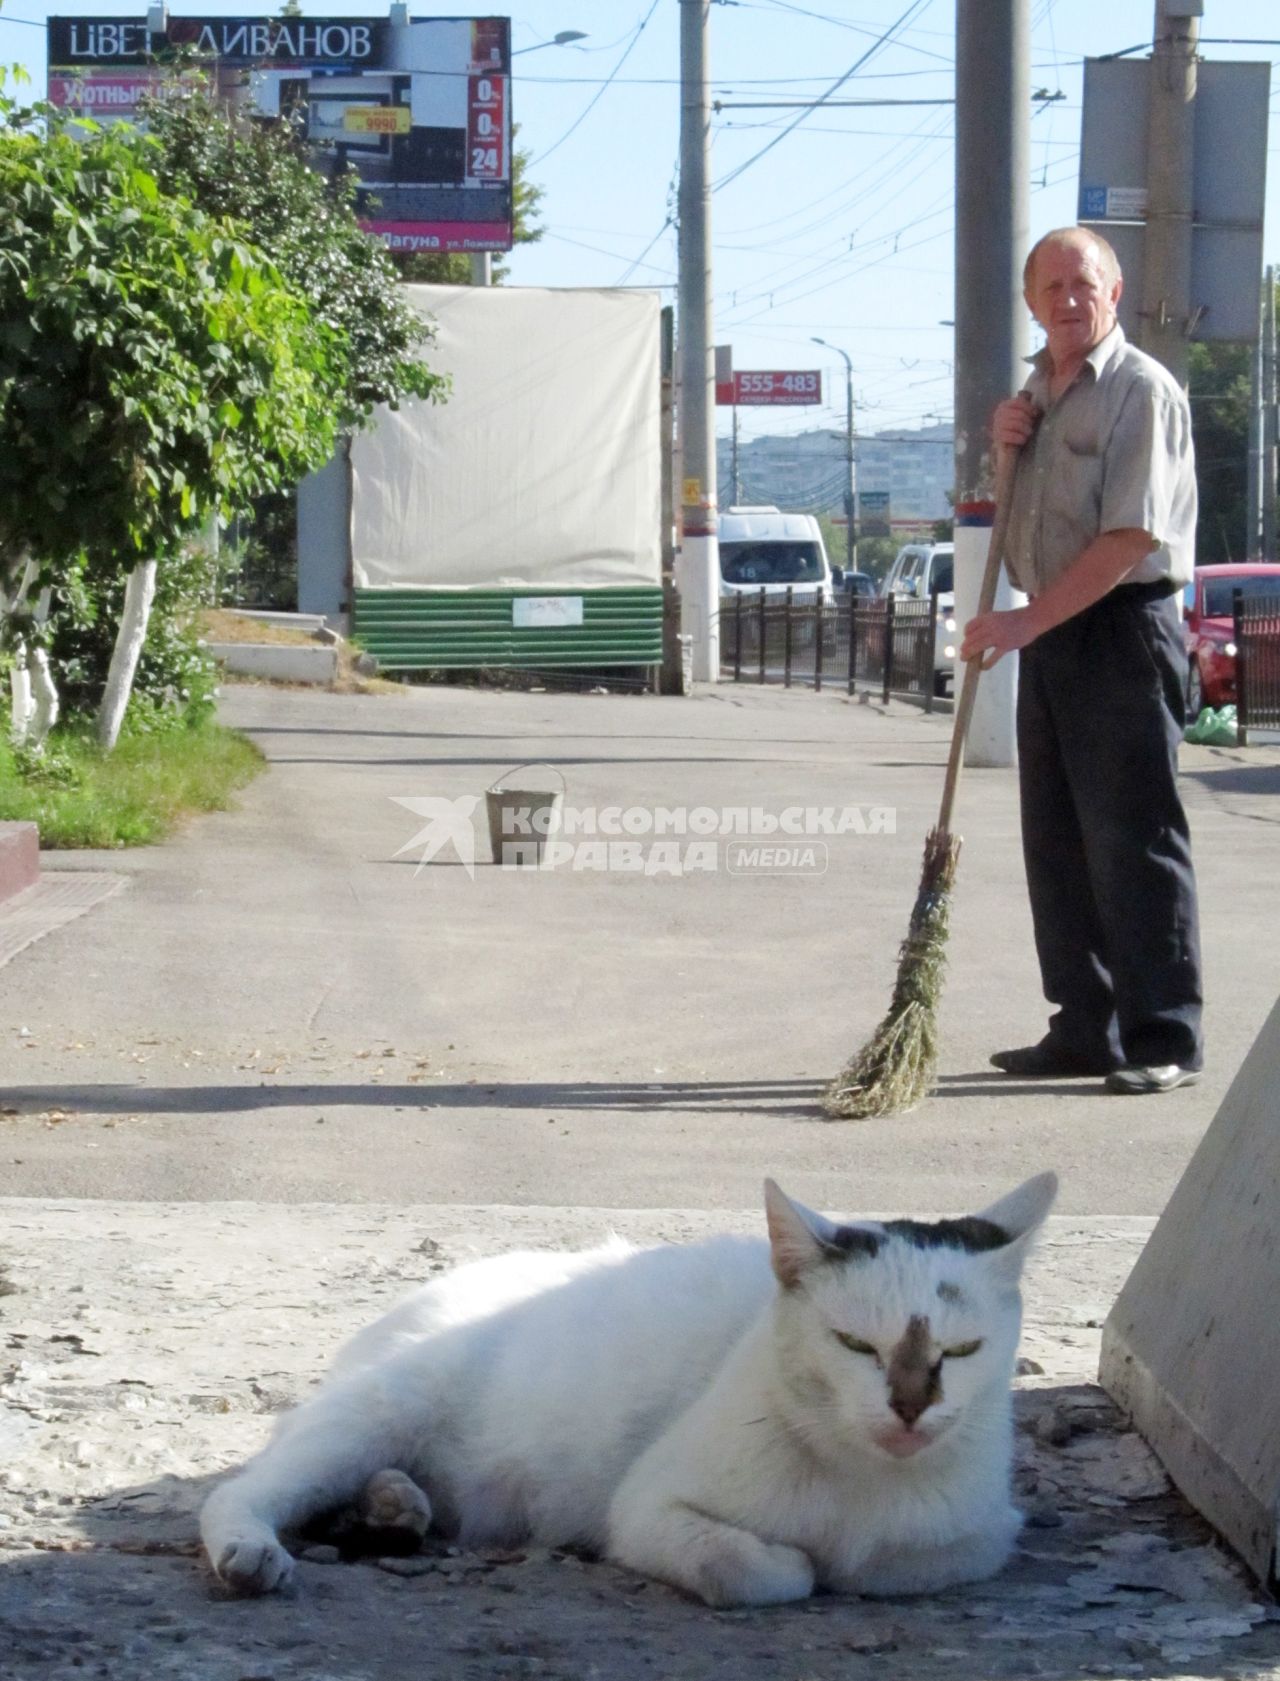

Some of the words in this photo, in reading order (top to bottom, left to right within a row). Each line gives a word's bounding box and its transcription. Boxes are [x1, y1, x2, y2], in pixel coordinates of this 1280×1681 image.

[70, 24, 153, 57] ЦВЕТ
[472, 148, 498, 170] 24
[740, 374, 817, 392] 555-483
